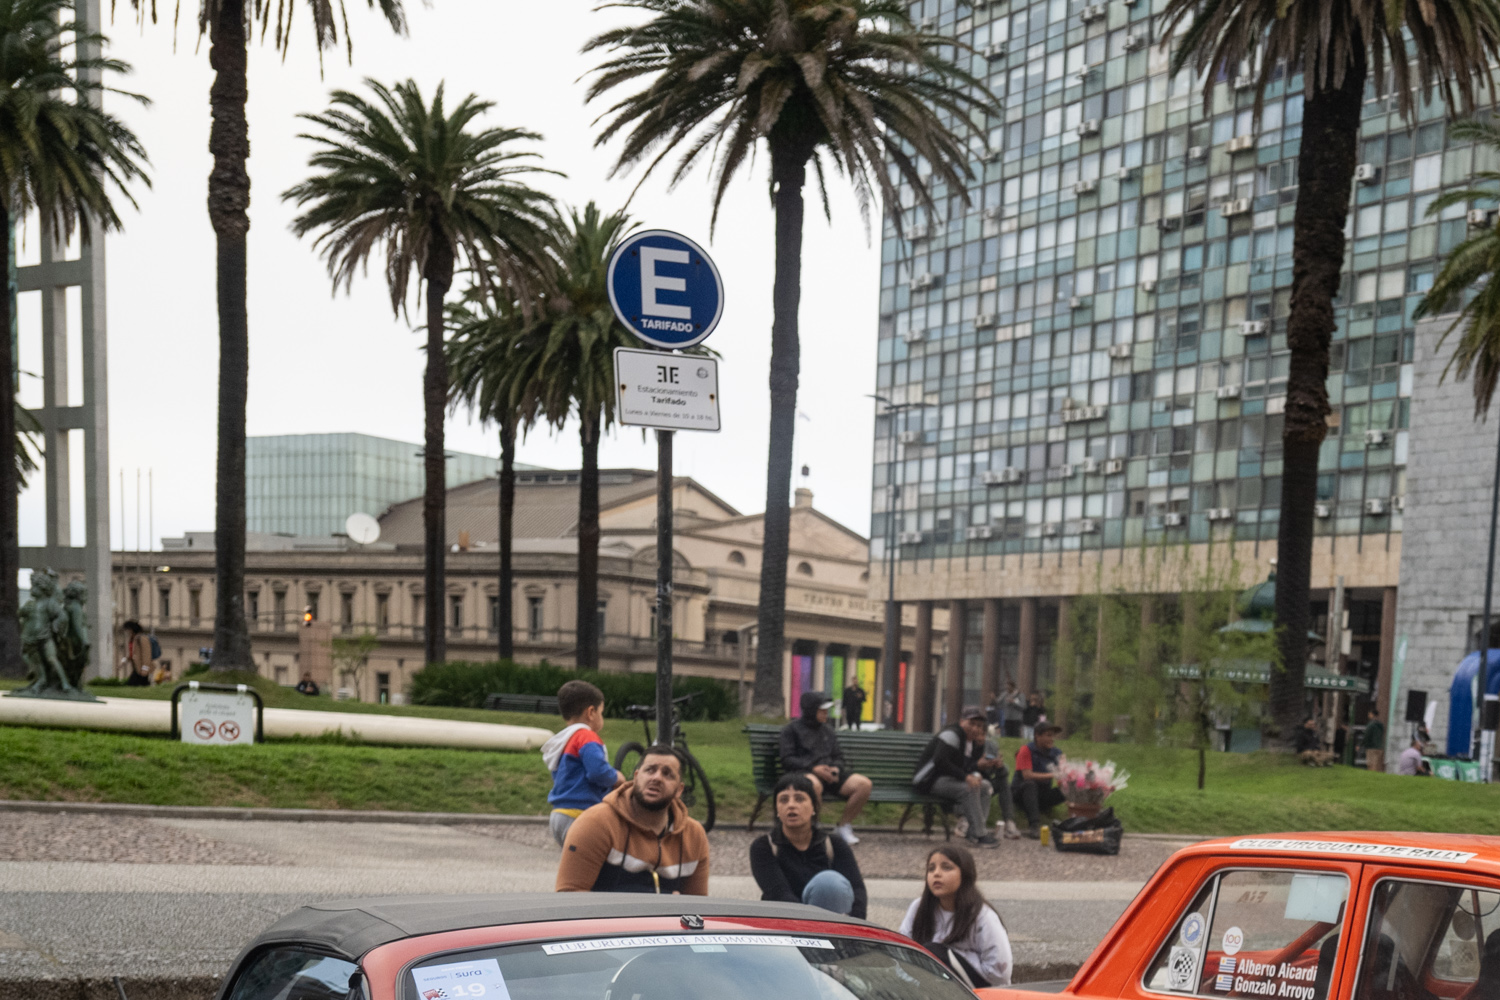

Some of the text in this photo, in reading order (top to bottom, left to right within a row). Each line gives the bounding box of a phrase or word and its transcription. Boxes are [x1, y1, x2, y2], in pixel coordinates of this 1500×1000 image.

[640, 246, 691, 319] E
[641, 318, 693, 333] TARIFADO
[637, 385, 698, 398] Estacionamiento
[651, 396, 687, 407] Tarifado
[1239, 838, 1469, 861] CLUB URUGUAYO DE RALLY
[550, 935, 823, 951] CLUB URUGUAYO DE AUTOMOVILES SPORT
[455, 969, 482, 979] sura
[1237, 958, 1318, 982] Alberto Aicardi
[451, 982, 487, 998] 19
[1234, 977, 1276, 996] Gonzalo
